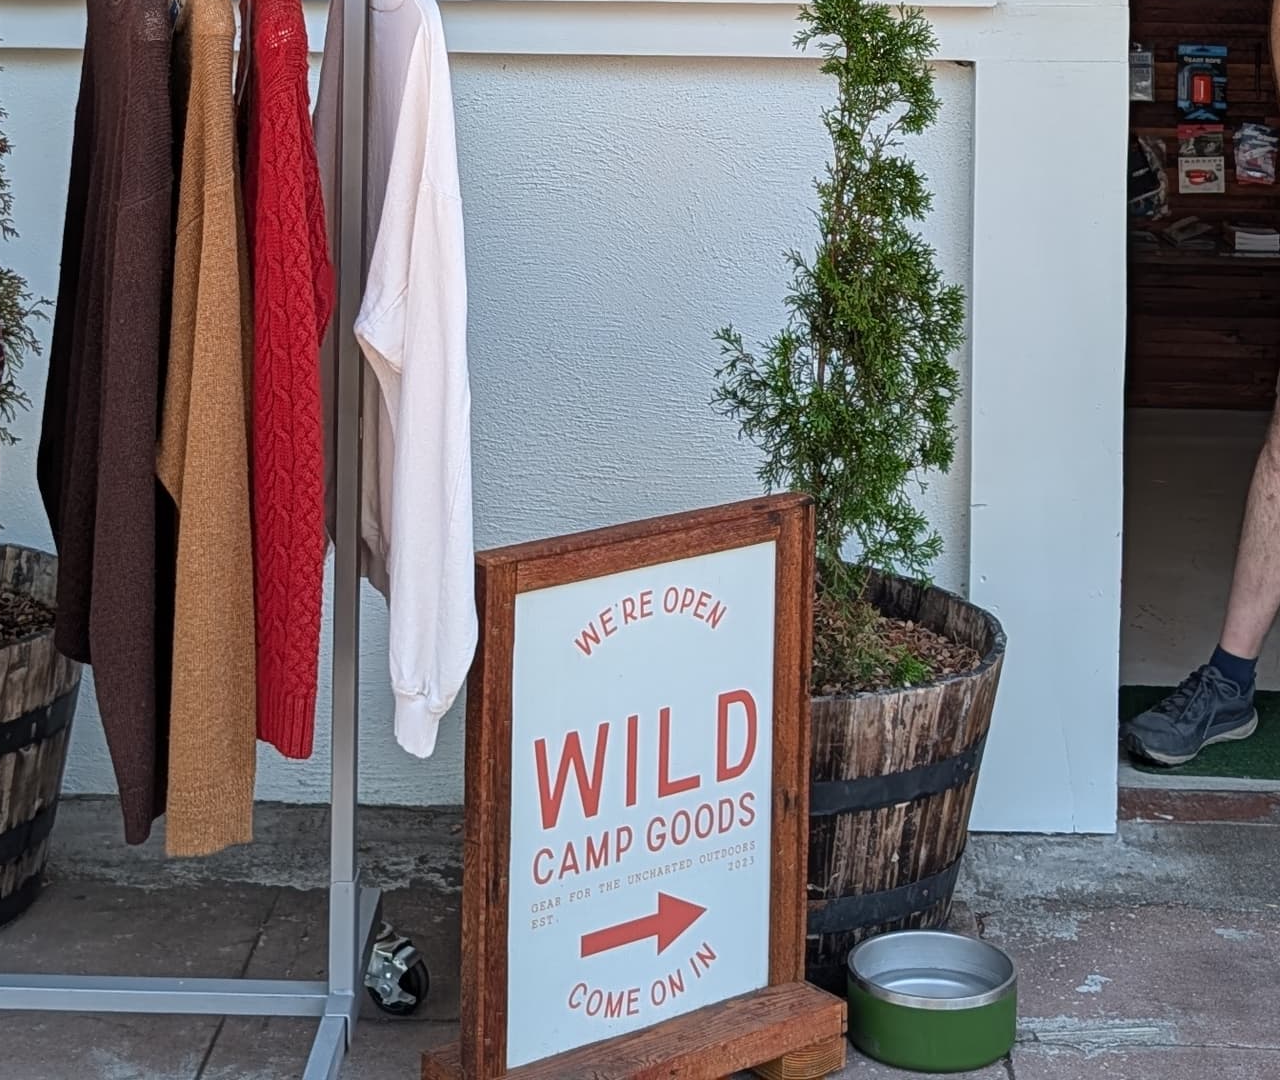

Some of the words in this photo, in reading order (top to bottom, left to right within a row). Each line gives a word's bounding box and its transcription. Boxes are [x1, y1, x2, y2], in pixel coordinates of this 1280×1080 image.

[574, 589, 653, 657] WE'RE
[663, 586, 728, 630] OPEN
[533, 688, 759, 831] WILD
[531, 897, 561, 913] GEAR
[569, 888, 591, 902] FOR
[599, 879, 621, 894] THE
[627, 858, 693, 886] UNCHARTED
[699, 841, 756, 864] OUTDOORS
[532, 824, 633, 886] CAMP
[646, 792, 757, 854] GOODS
[531, 914, 560, 930] EST.
[727, 856, 755, 872] 2023
[568, 982, 640, 1019] COME
[651, 968, 686, 1007] ON
[694, 941, 718, 978] IN
